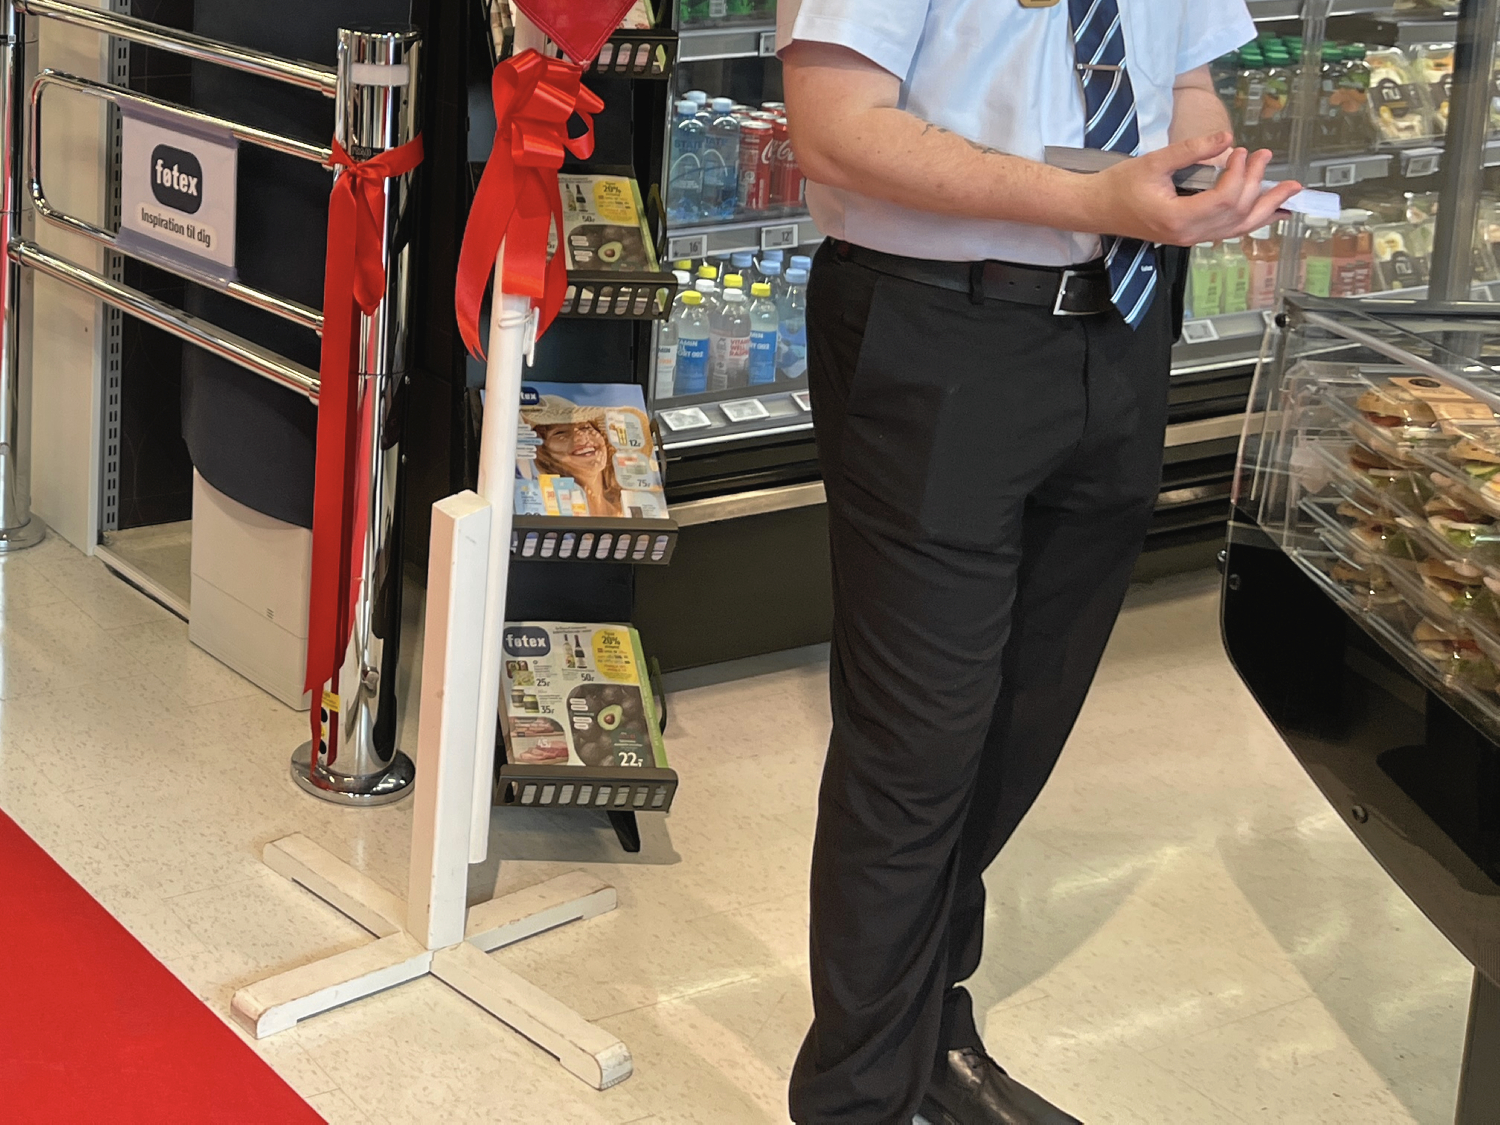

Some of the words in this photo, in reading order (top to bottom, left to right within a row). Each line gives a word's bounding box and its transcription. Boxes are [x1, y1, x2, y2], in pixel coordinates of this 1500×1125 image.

[155, 159, 198, 197] føtex
[141, 207, 185, 238] Inspiration
[186, 221, 196, 240] til
[197, 225, 211, 248] dig
[520, 391, 538, 401] tex
[505, 634, 547, 648] føtex
